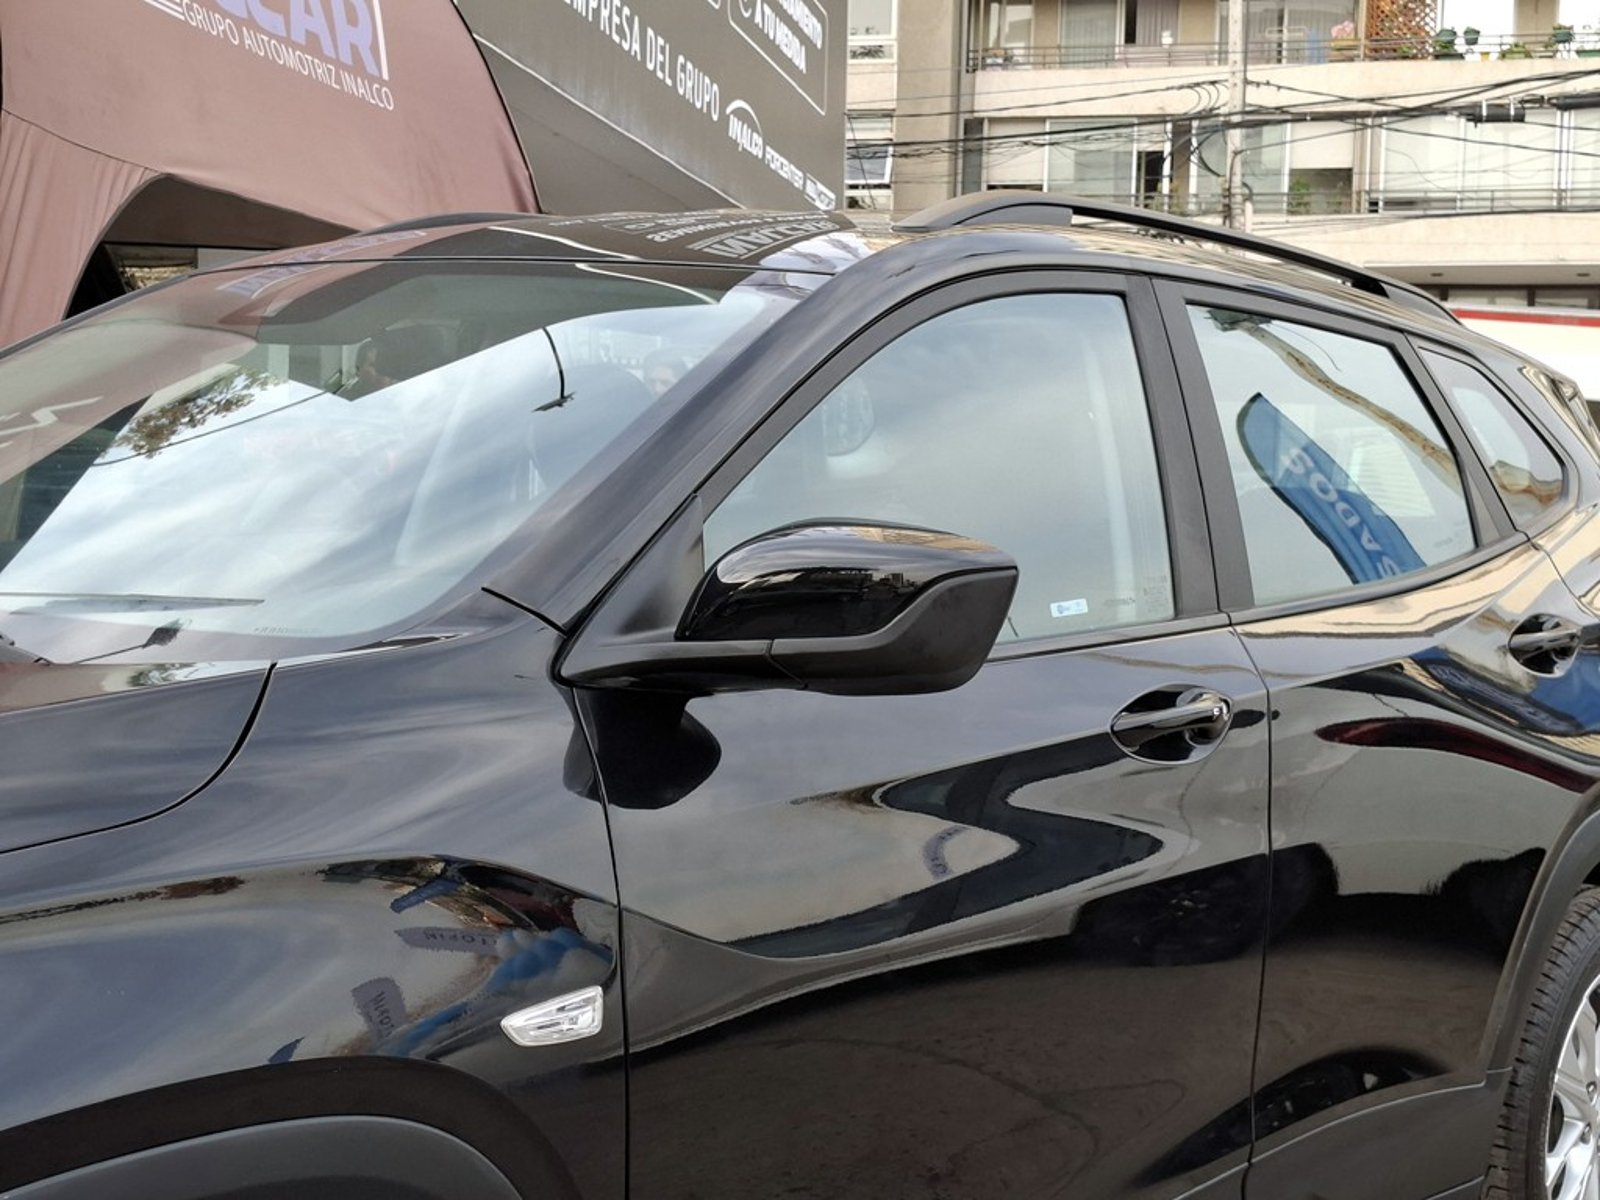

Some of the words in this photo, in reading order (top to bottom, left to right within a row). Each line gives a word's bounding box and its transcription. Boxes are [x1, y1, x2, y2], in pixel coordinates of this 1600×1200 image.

[182, 0, 240, 46] GRUPO
[242, 25, 341, 90] AUTOMOTRIZ
[339, 70, 395, 111] INALCO
[563, 0, 642, 62] PRESA
[645, 26, 673, 87] DEL
[676, 54, 720, 122] GRUPO
